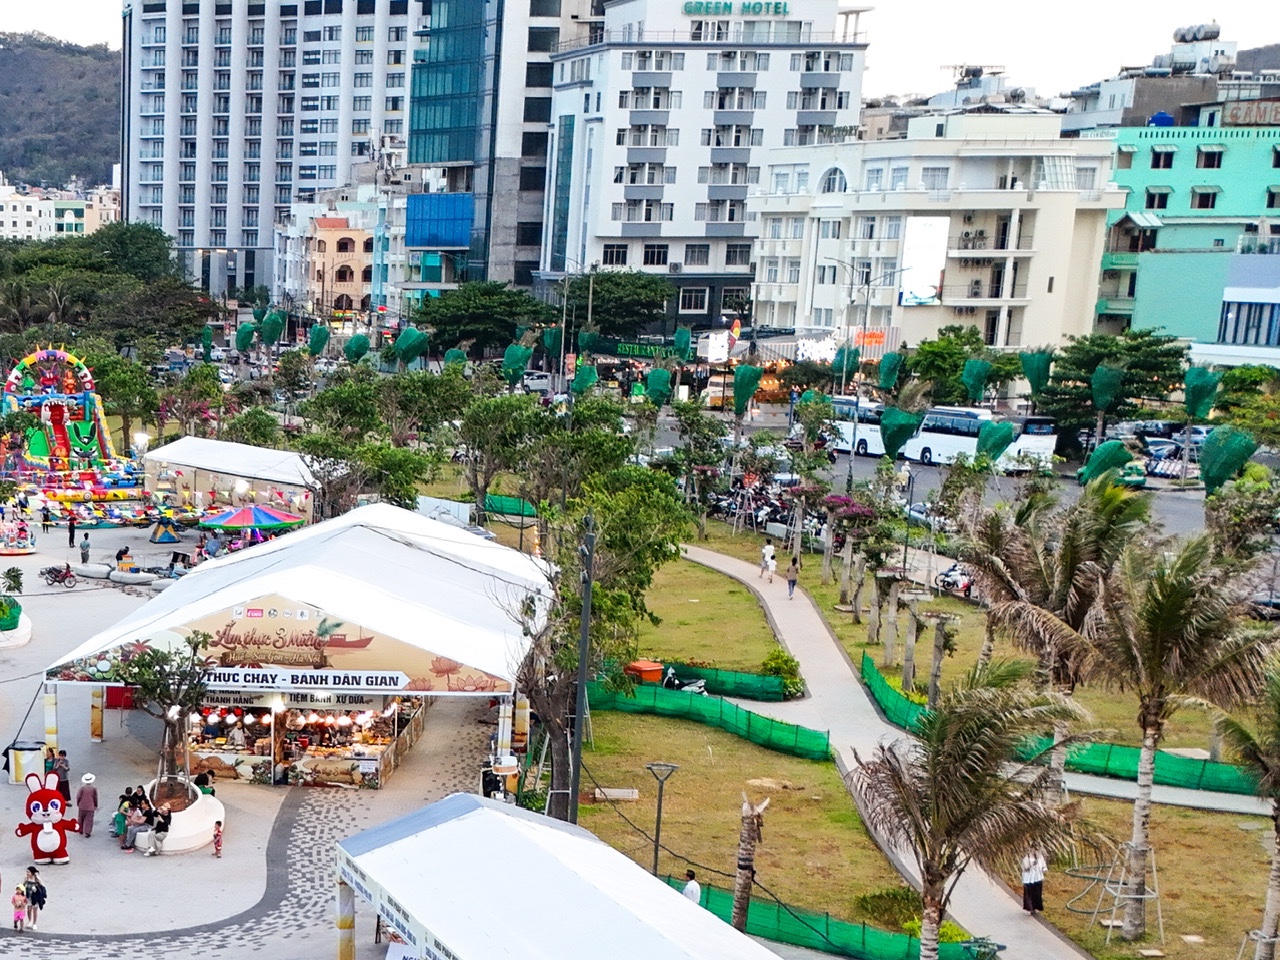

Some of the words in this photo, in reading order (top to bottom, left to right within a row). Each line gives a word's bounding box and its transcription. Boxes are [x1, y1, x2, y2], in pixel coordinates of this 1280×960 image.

[683, 1, 733, 15] GREEN
[741, 1, 790, 15] HOTEL
[273, 627, 287, 649] 3
[243, 673, 278, 684] CHAY
[290, 672, 329, 686] BÁNH
[332, 672, 361, 686] DÂN
[365, 676, 399, 687] GIAN
[290, 693, 307, 704] TIỆM
